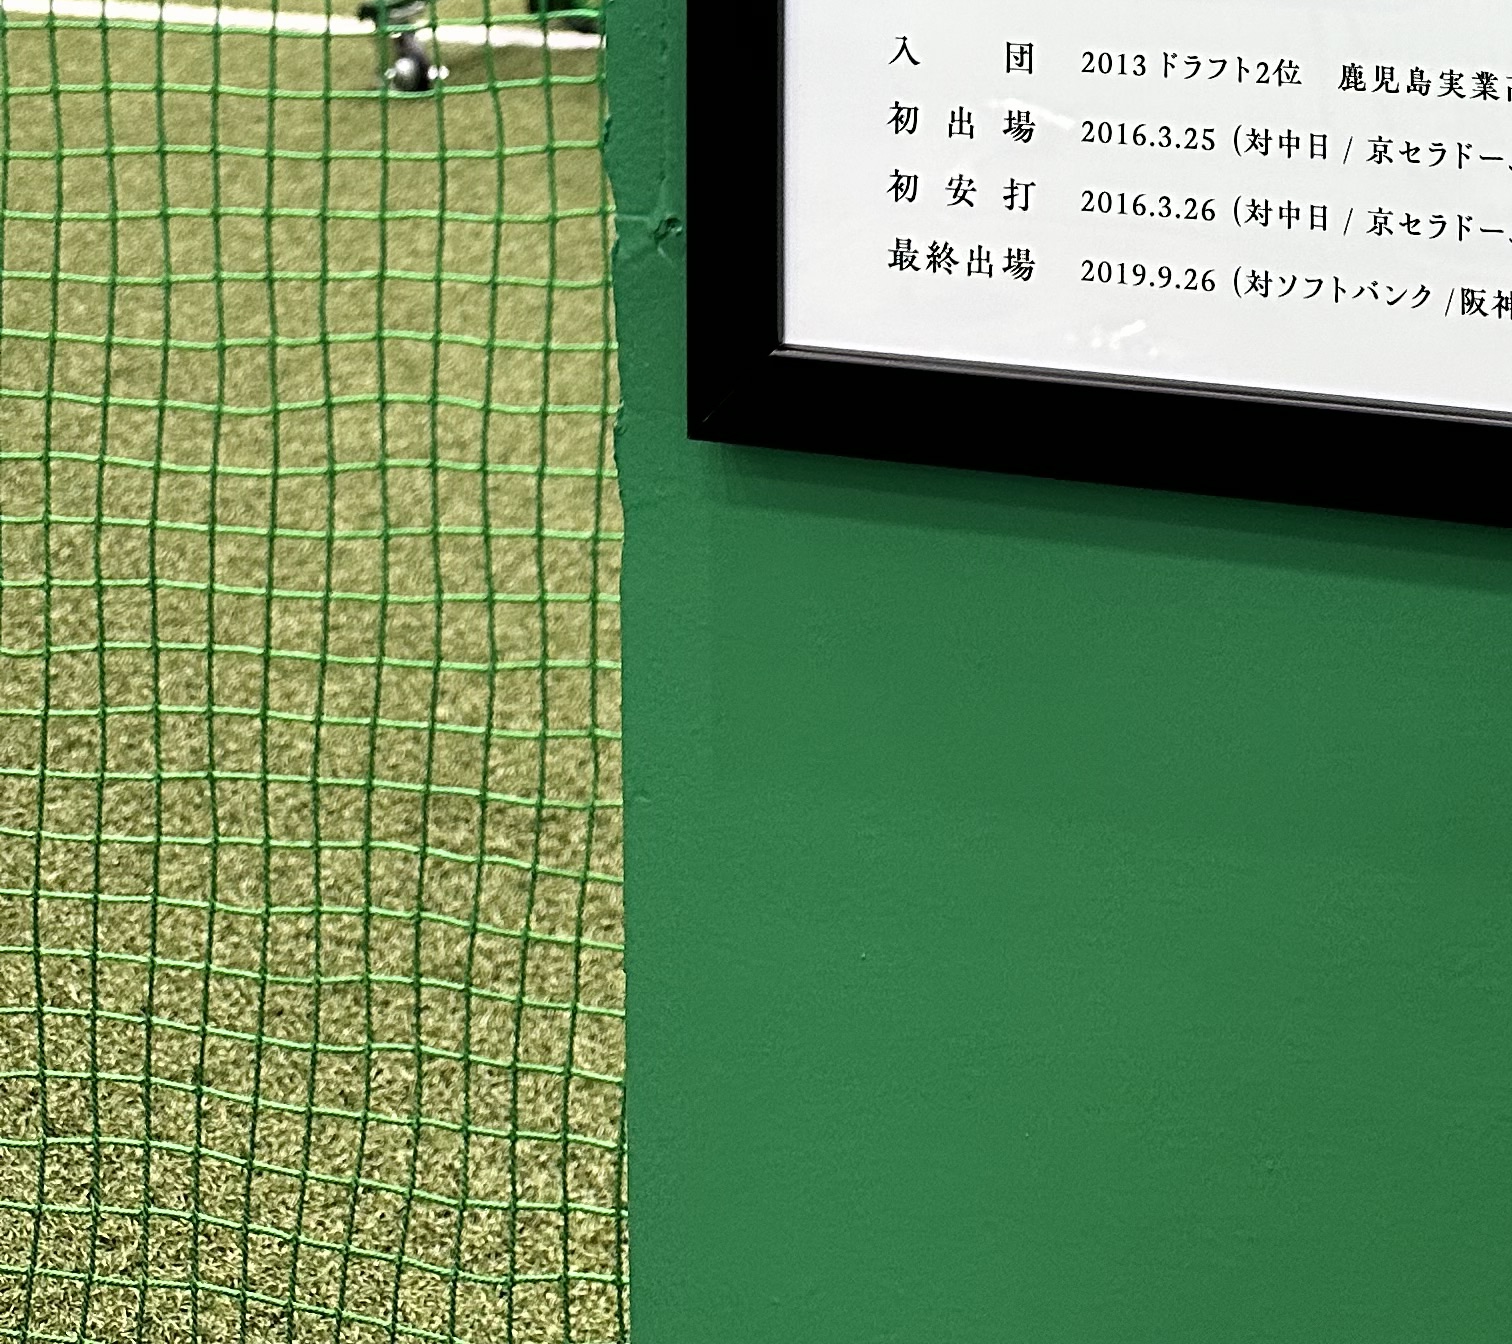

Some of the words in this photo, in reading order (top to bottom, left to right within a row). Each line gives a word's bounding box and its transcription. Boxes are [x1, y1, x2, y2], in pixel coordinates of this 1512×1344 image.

[1080, 50, 1148, 78] 2013
[1160, 51, 1304, 88] ドラフト2位
[1080, 120, 1217, 153] 2016.3.25
[1080, 189, 1217, 223] 2016.3.26
[886, 236, 1038, 282] 最終出場
[1080, 258, 1217, 293] 2019.9.26
